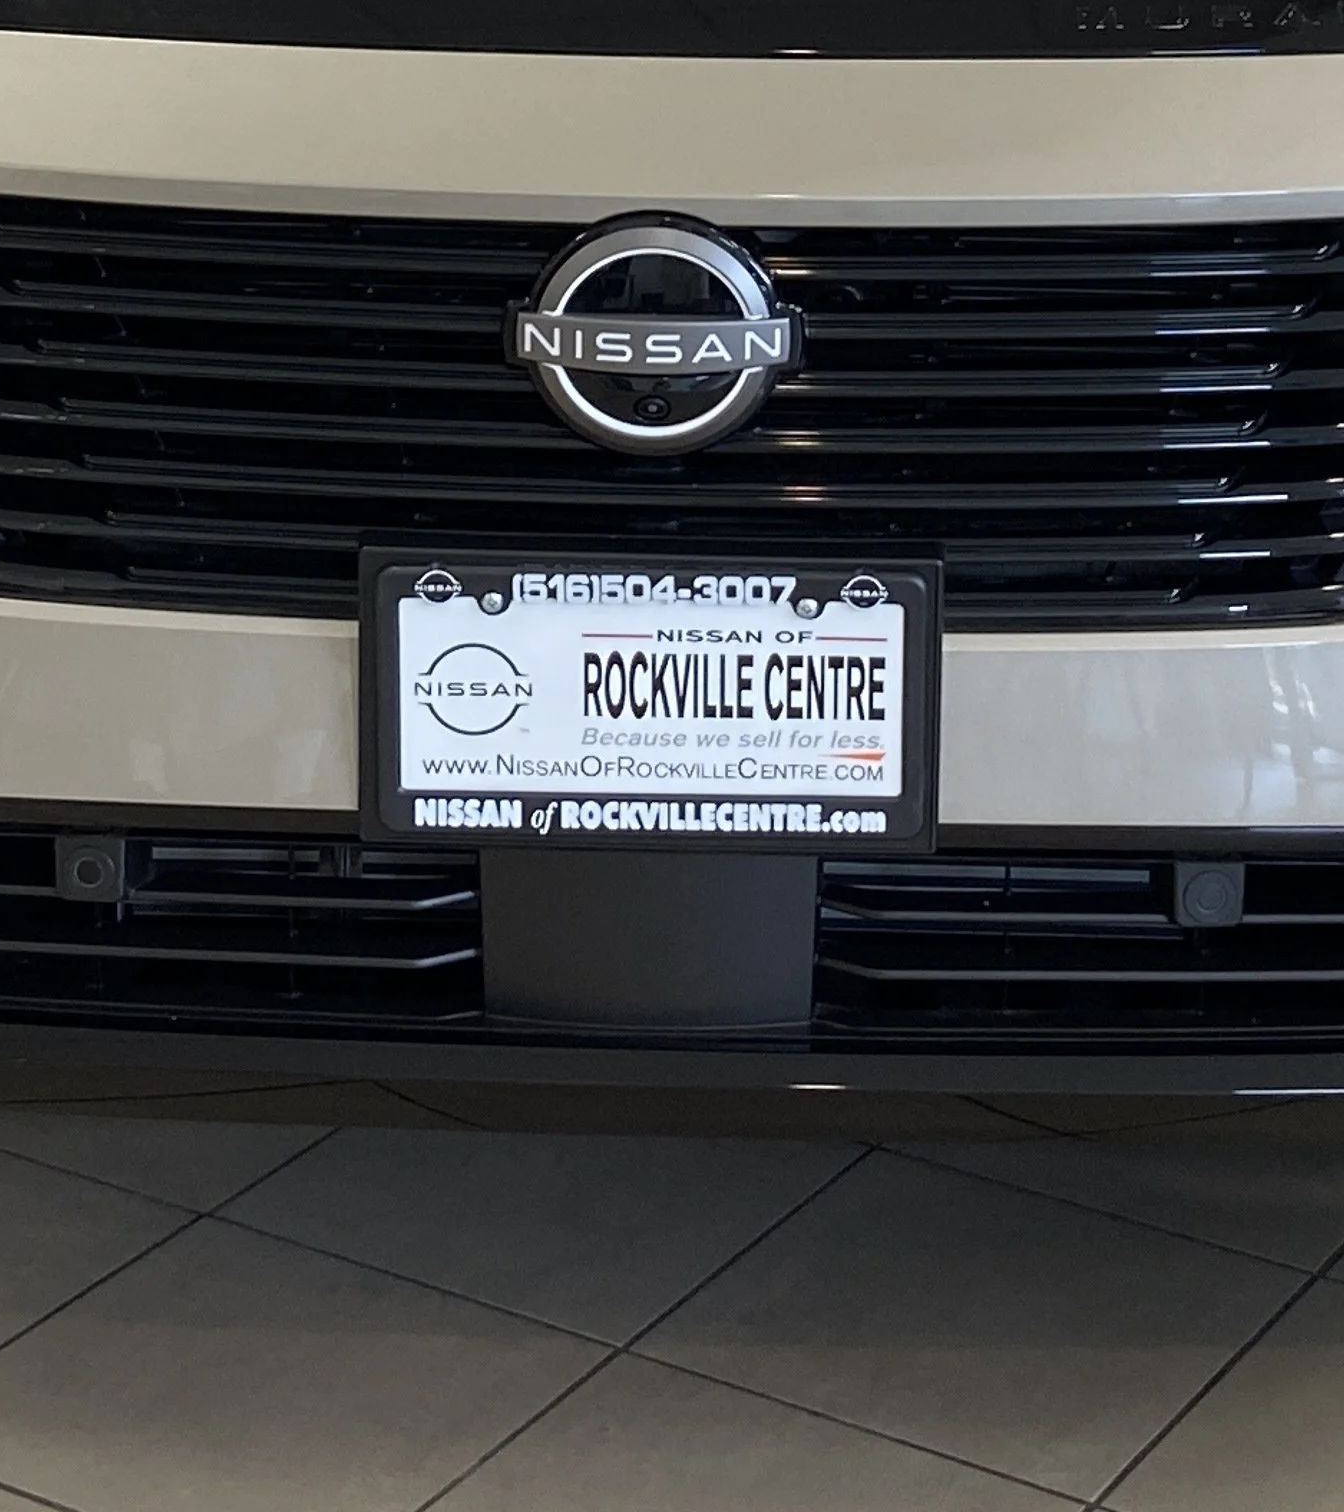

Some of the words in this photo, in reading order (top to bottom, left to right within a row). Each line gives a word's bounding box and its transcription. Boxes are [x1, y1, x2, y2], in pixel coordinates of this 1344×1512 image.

[522, 322, 782, 365] NISSAN
[414, 584, 462, 593] NISSAN
[512, 573, 796, 604] (516)504-3007
[840, 589, 889, 599] NISSAN
[656, 629, 763, 643] NISSAN
[775, 630, 813, 644] OF
[414, 681, 533, 697] NISSAN
[583, 650, 754, 719] ROCKVILLE
[764, 652, 886, 721] CENTRE
[581, 727, 687, 747] Because
[696, 732, 730, 748] we
[738, 728, 781, 749] sell
[789, 729, 824, 749] for
[830, 730, 886, 750] less.
[414, 798, 522, 829] NISSAN
[530, 801, 558, 835] of
[559, 799, 888, 835] ROCKVILLECENTRE.com
